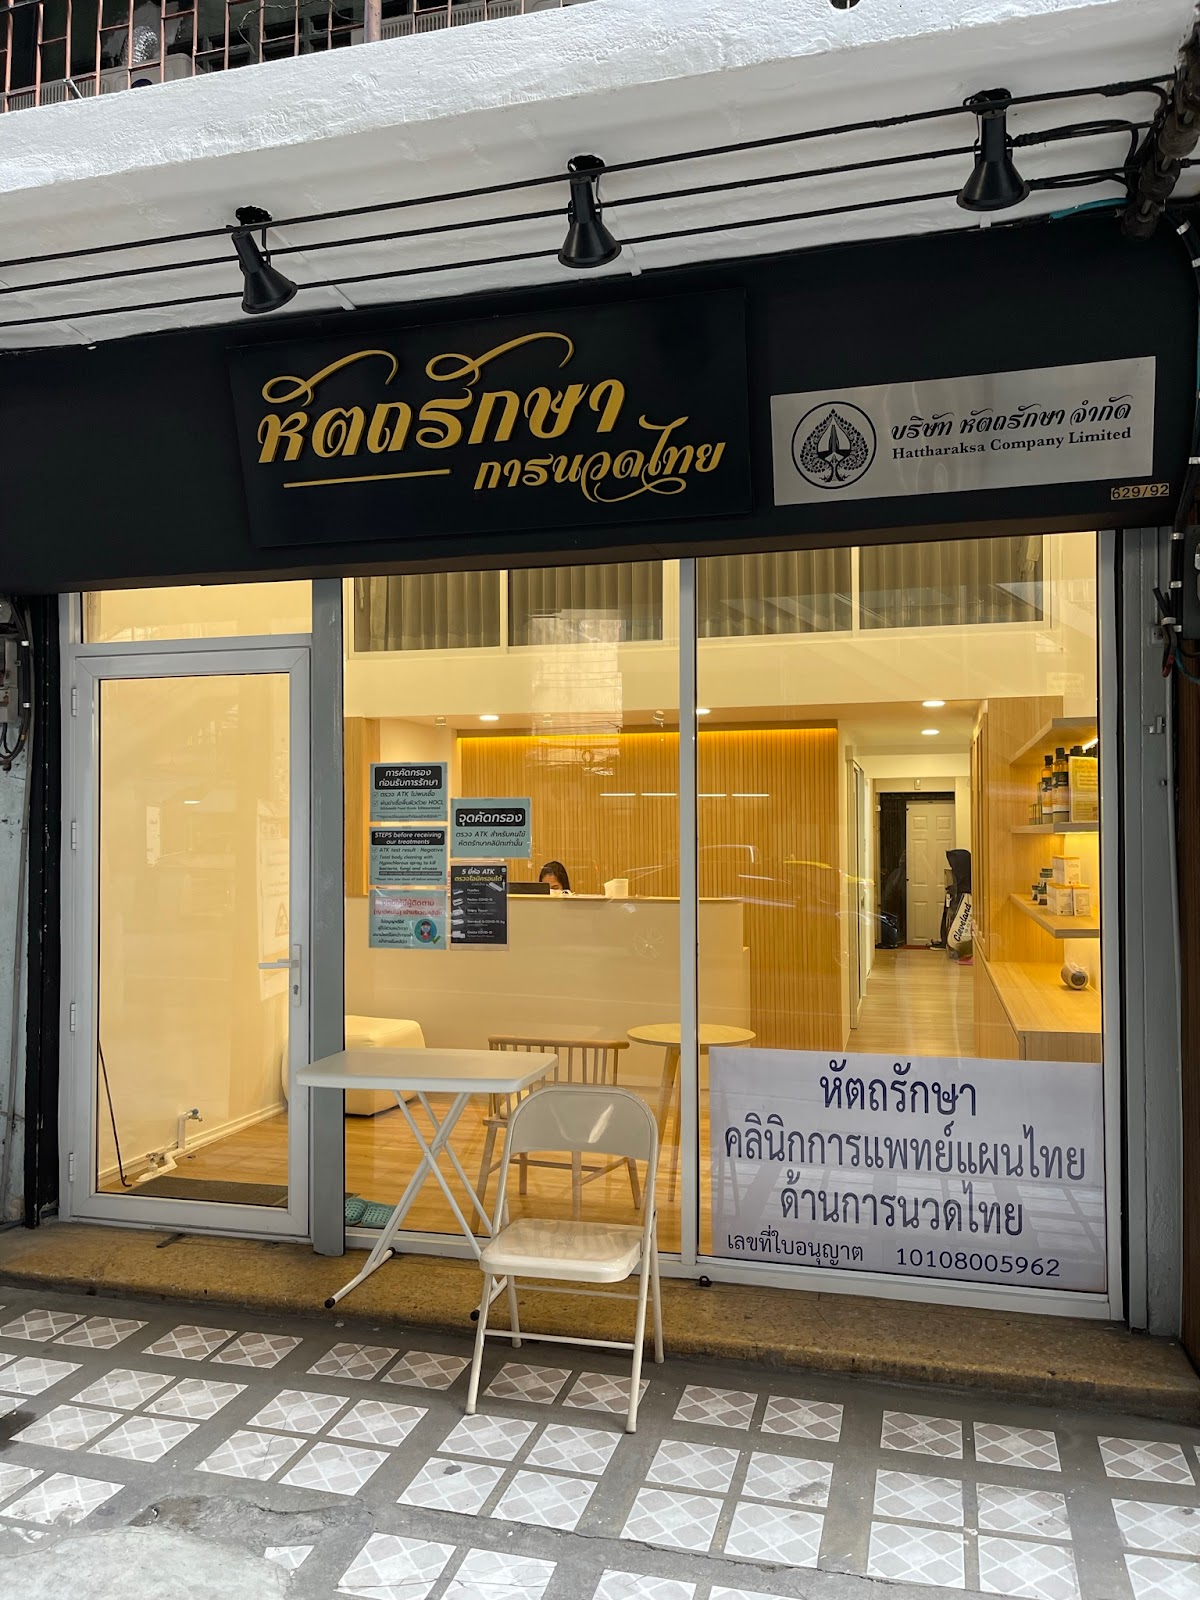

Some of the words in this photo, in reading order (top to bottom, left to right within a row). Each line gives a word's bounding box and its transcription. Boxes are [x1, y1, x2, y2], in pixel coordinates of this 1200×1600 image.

[257, 331, 626, 464] หัตถรักษา
[891, 411, 955, 441] บริษัท
[959, 403, 1066, 435] หัตถรักษา
[1069, 394, 1134, 426] จำกัด
[473, 415, 726, 503] การนวดไทย
[892, 443, 986, 460] Hattharaksa
[990, 434, 1065, 453] Company
[1068, 427, 1132, 444] Limited
[1111, 484, 1170, 500] 629/92
[378, 778, 439, 787] ก่อนรับการรักษา
[385, 768, 432, 777] การคัดกรอง
[459, 811, 523, 826] จุดคัดกรอง
[954, 902, 971, 941] Cleveland
[819, 1059, 977, 1117] หัตถรักษา
[724, 1112, 1086, 1181] คลินิกการแพทย์แผนไทย
[780, 1169, 1024, 1237] ด้านการนวดไทย
[727, 1225, 864, 1266] เลขที่ใบอนุญาต
[896, 1247, 1061, 1277] 10108005962
